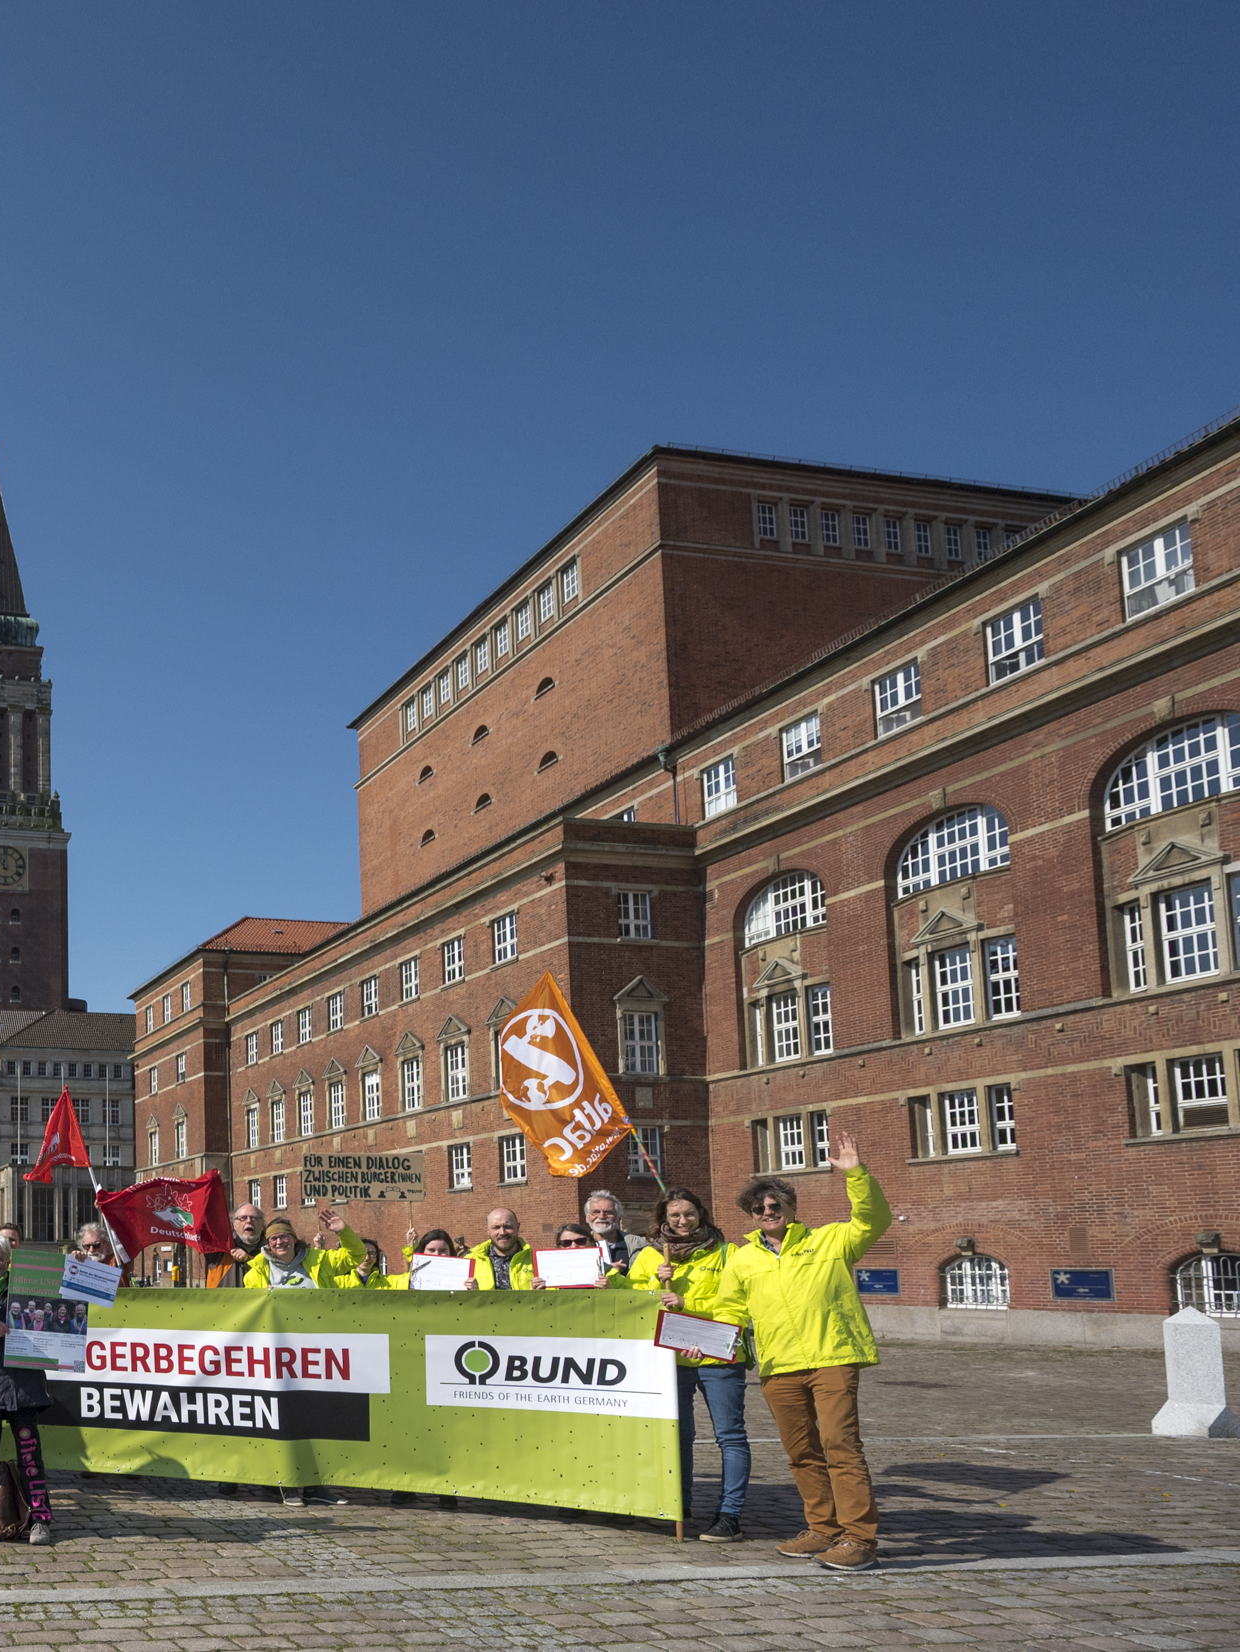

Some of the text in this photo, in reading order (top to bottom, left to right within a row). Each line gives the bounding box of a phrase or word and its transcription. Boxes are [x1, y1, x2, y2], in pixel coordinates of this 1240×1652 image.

[304, 1154, 411, 1171] FÜR EINEN DIALOG
[304, 1169, 358, 1183] ZWISCHEN
[304, 1184, 372, 1198] UND POLITIK
[13, 1275, 60, 1287] offene LISTE
[86, 1340, 351, 1381] GERBEGEHREN
[504, 1355, 627, 1386] BUND
[454, 1390, 628, 1408] FRIENDS OF THE EARTH GERMANY
[80, 1387, 280, 1430] BEWAHREN
[29, 1480, 52, 1521] LISTE
